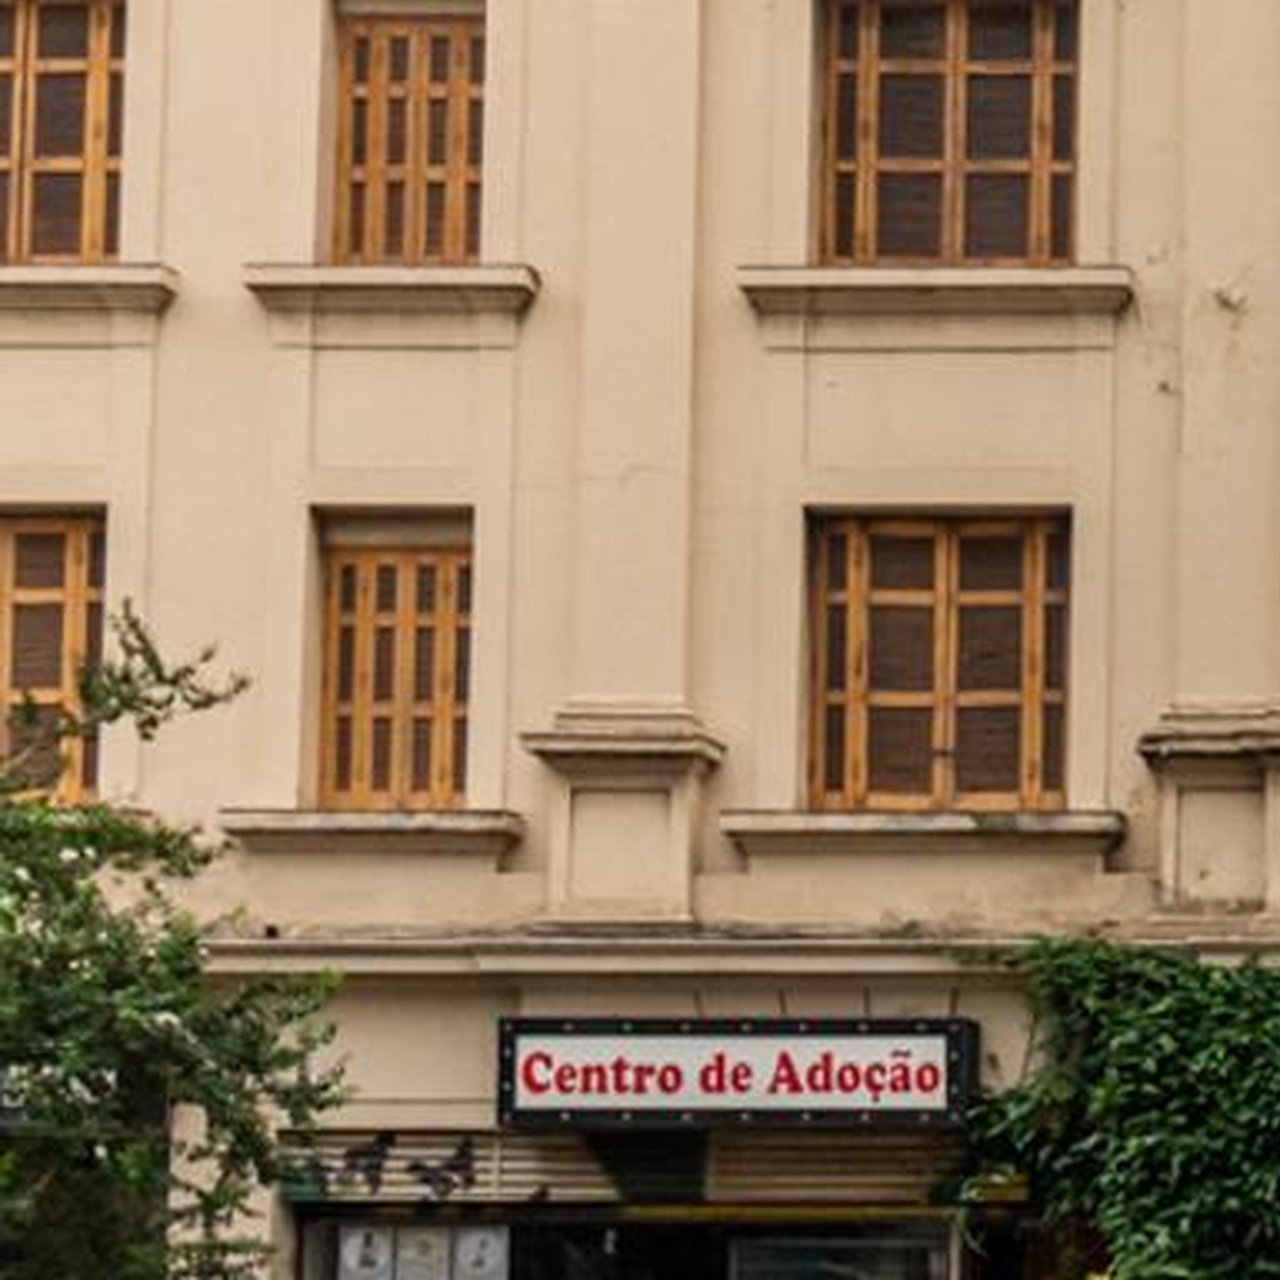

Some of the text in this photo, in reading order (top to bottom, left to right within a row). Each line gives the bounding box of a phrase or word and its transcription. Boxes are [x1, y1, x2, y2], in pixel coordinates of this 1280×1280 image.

[520, 1049, 941, 1103] Centro de Adoção
